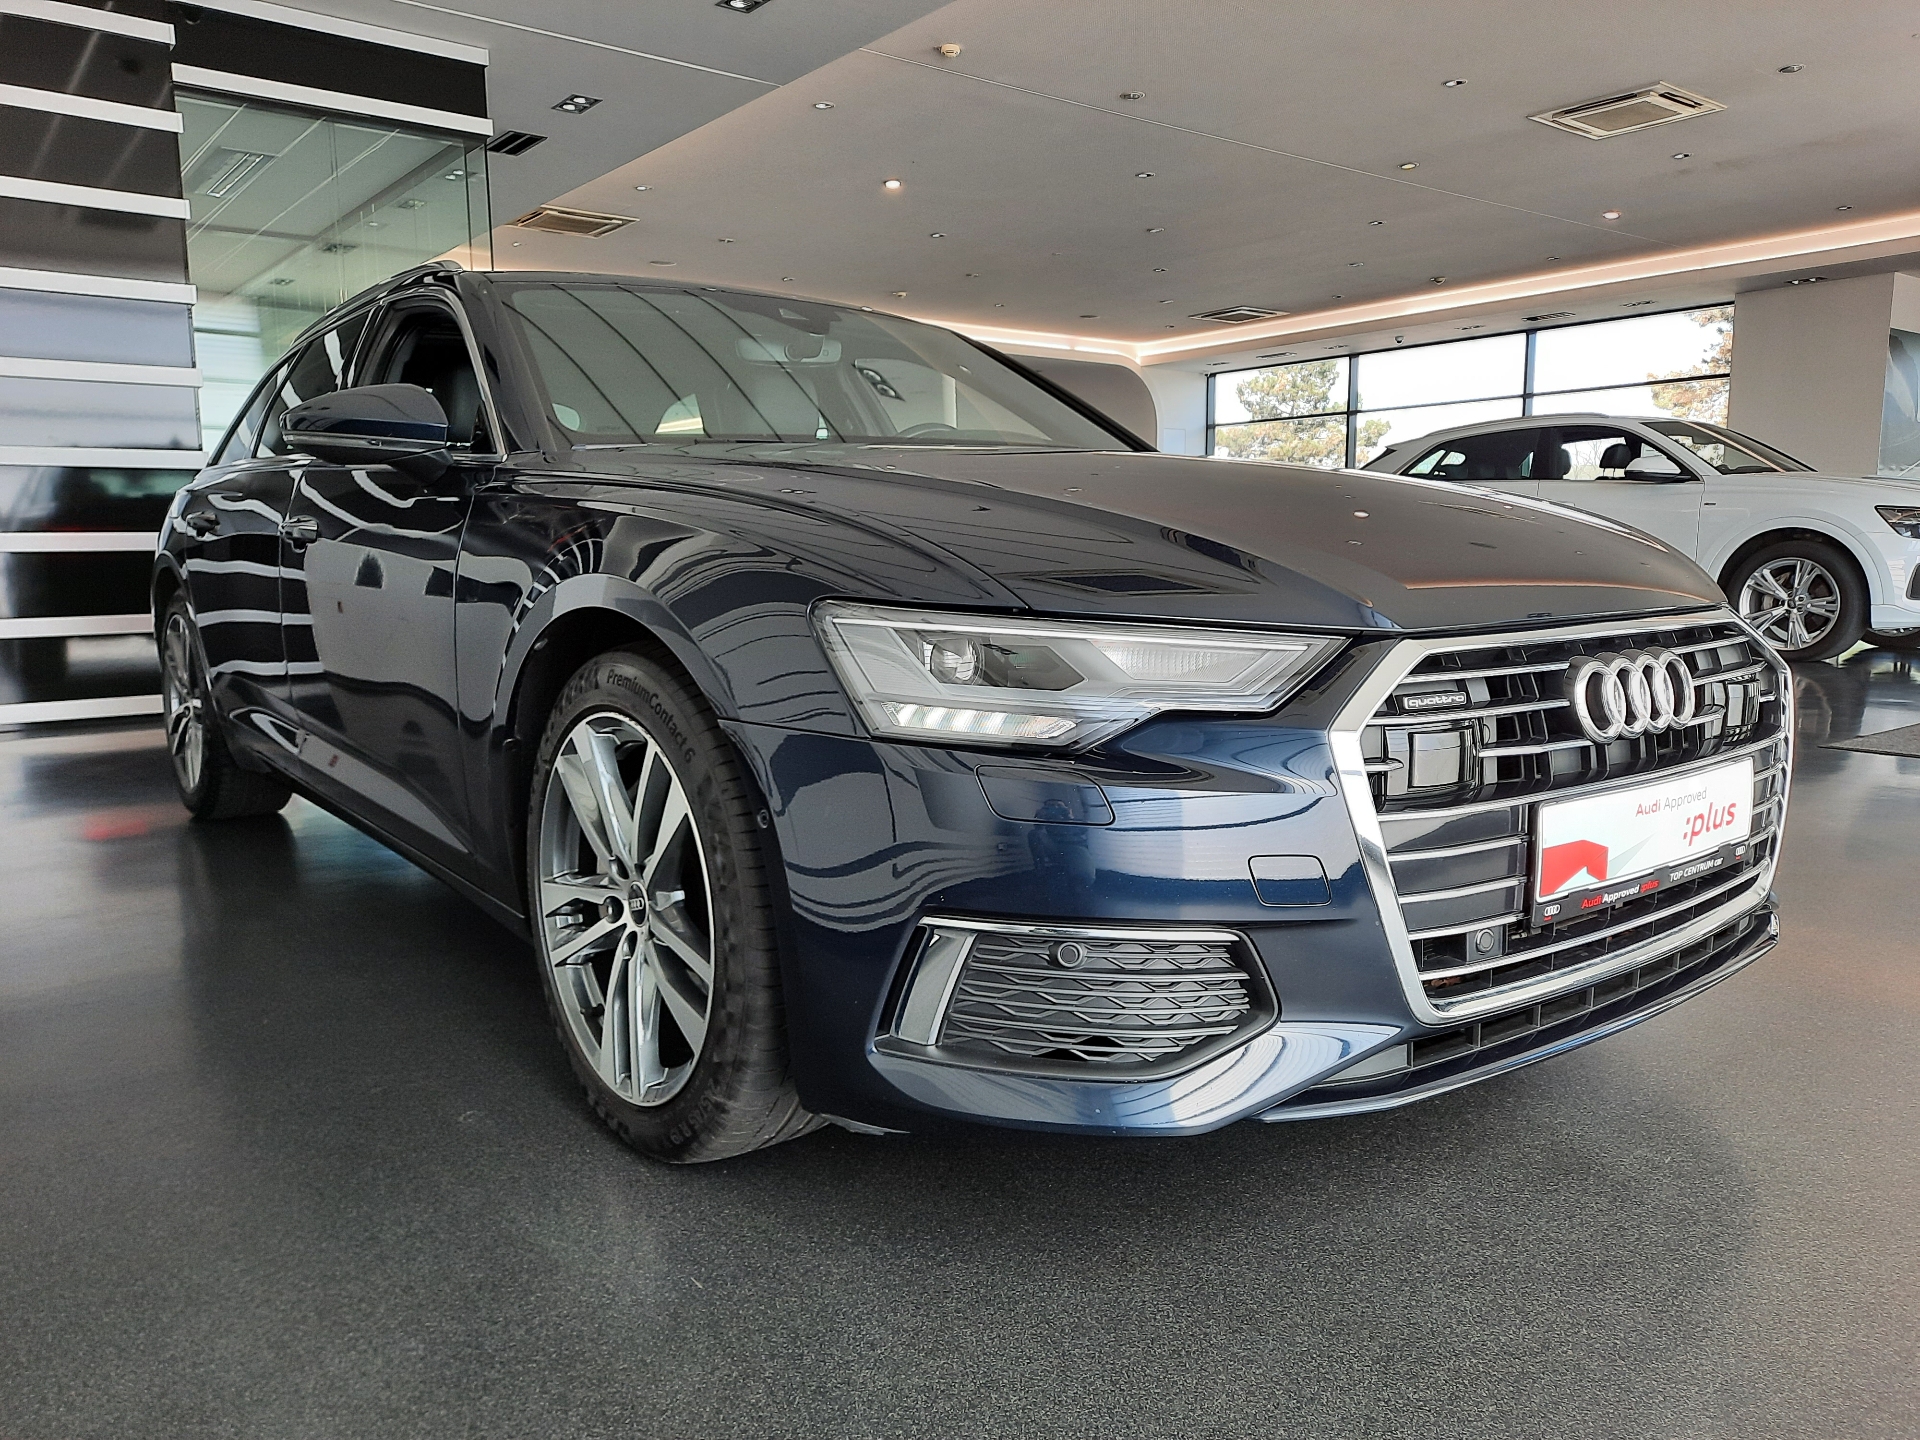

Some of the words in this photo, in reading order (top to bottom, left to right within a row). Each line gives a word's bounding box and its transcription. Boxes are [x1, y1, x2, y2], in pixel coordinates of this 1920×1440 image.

[1408, 694, 1465, 708] quattro
[606, 668, 689, 750] PremiumContact
[684, 749, 696, 764] 6
[1635, 799, 1661, 817] Audi
[1663, 786, 1708, 812] Approved
[1683, 802, 1737, 847] :plus
[1670, 870, 1684, 882] TOP
[1684, 859, 1714, 877] CENTRUM
[1581, 895, 1602, 909] Audi
[1602, 884, 1640, 904] Approved
